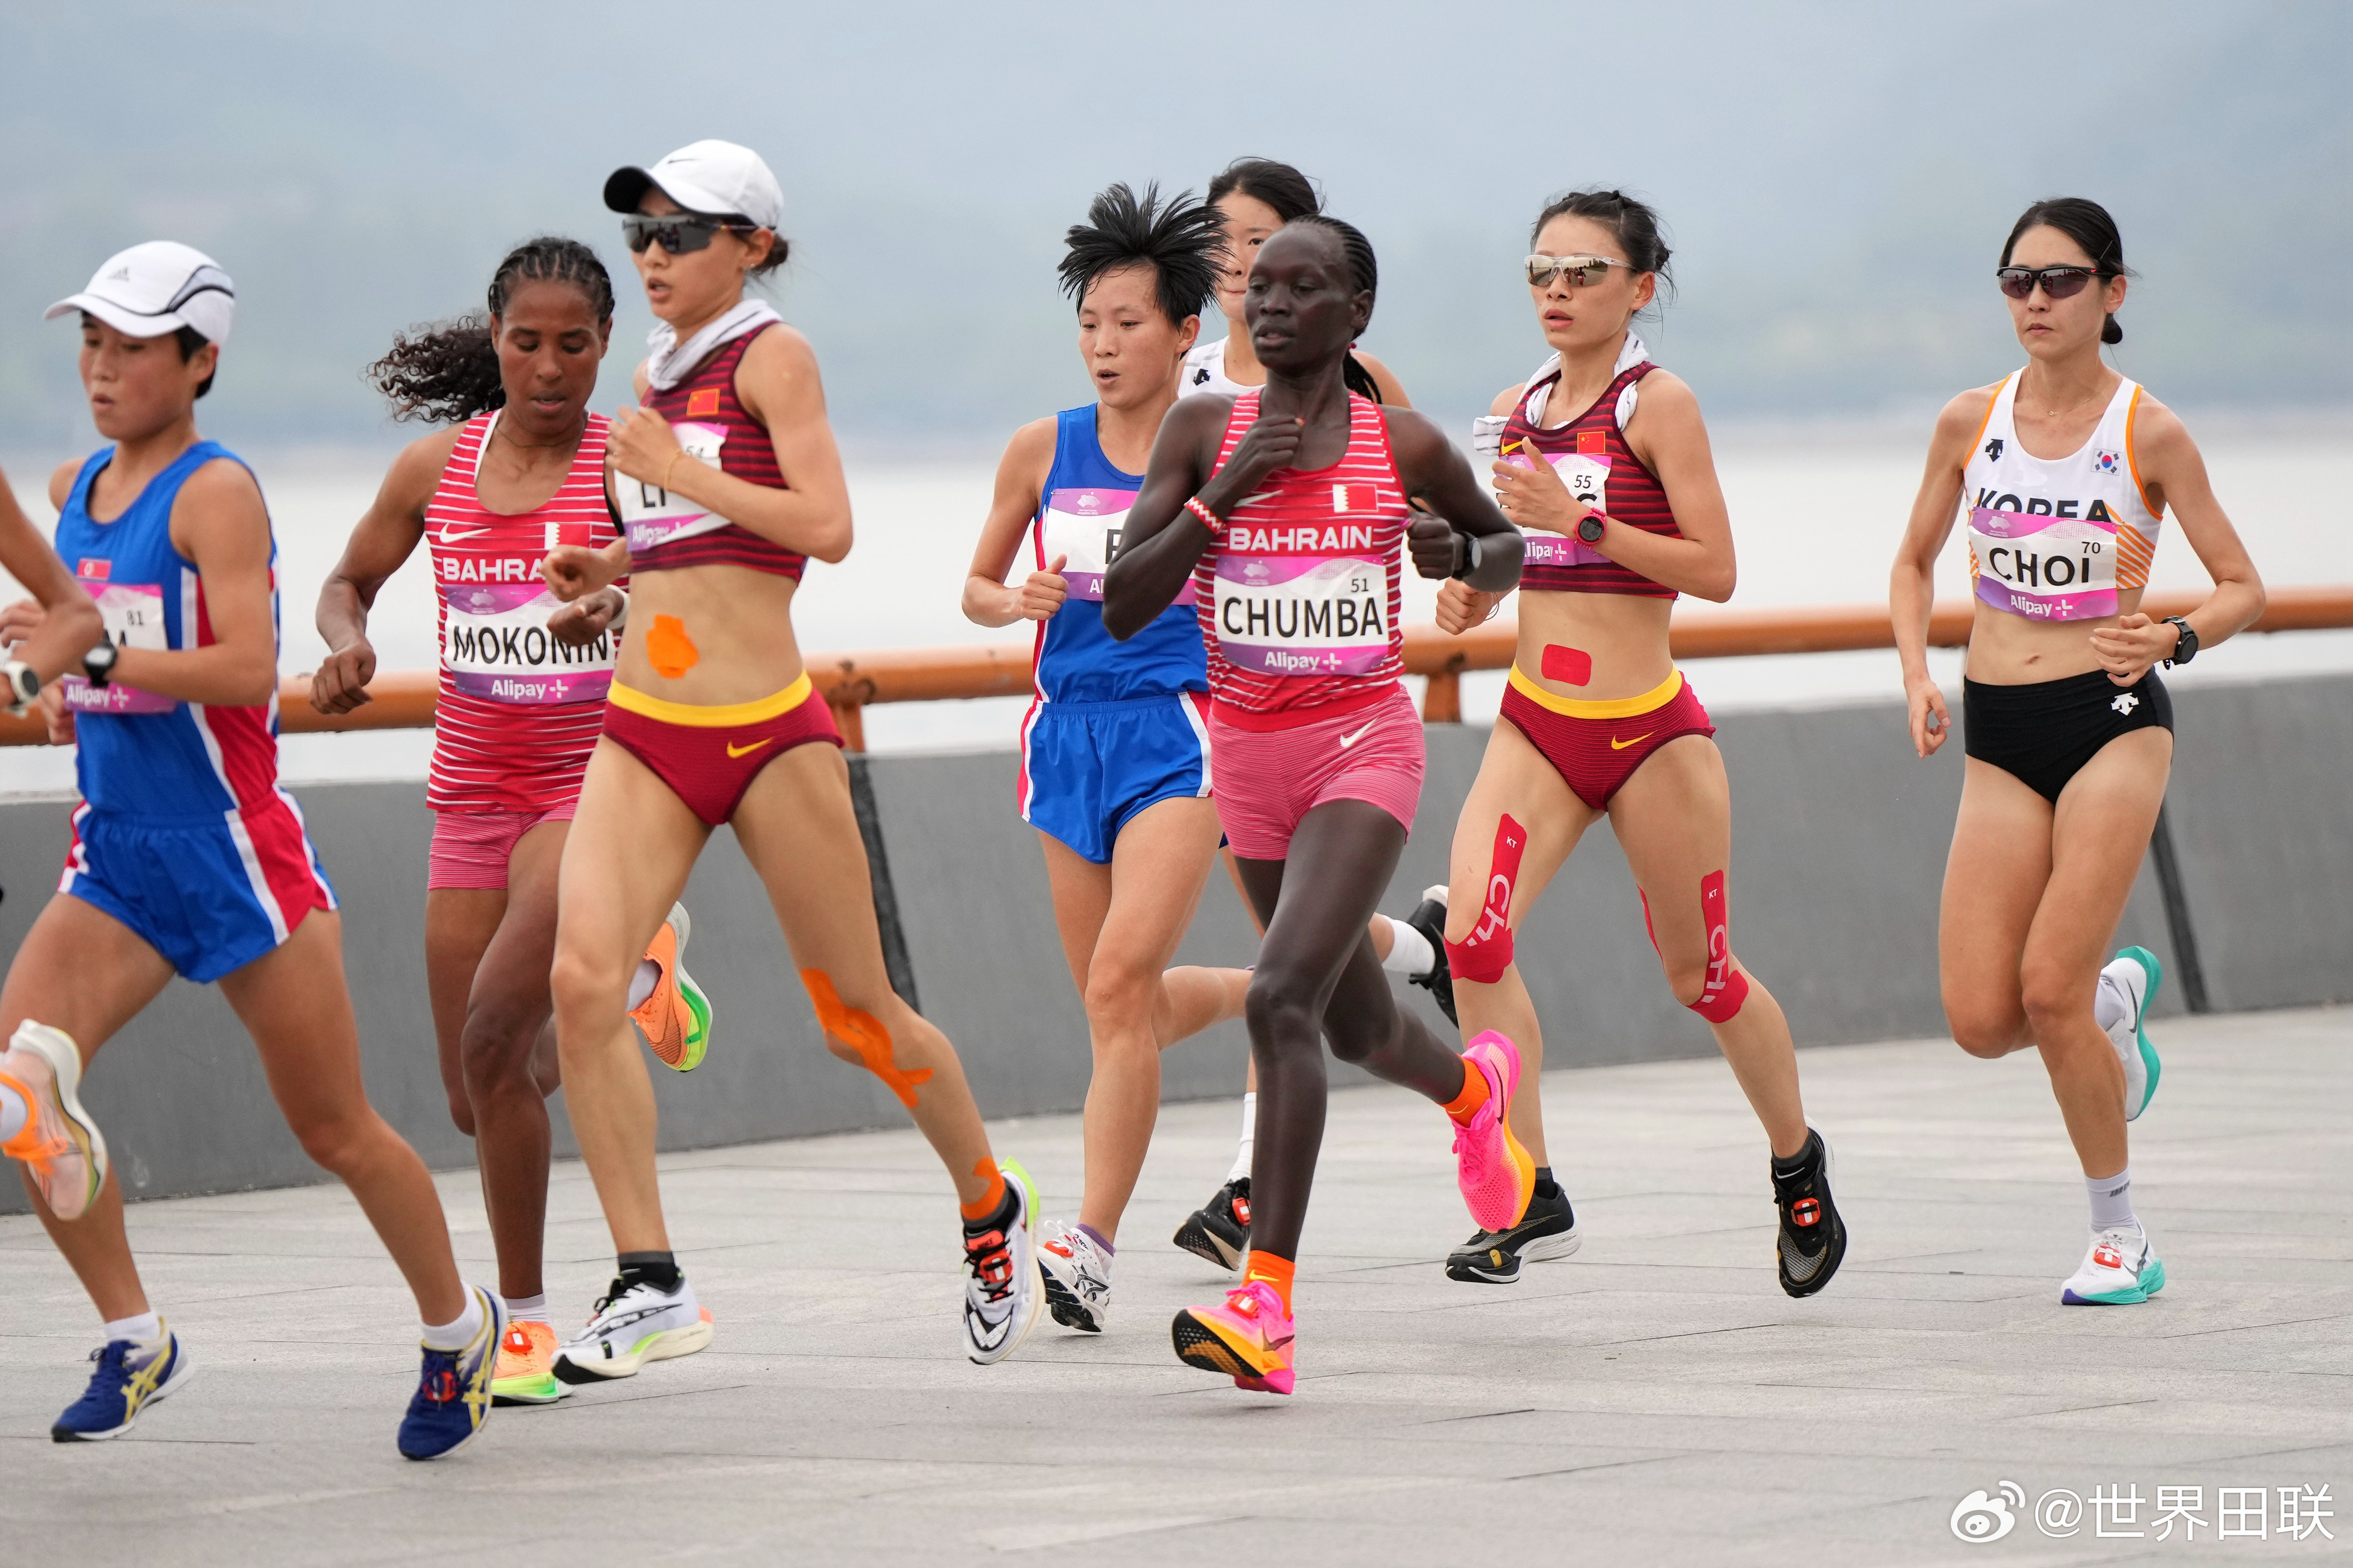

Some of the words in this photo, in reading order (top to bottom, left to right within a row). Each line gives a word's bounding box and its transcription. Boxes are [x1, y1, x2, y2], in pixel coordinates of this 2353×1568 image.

[1574, 475, 1592, 489] 55
[1229, 526, 1372, 551] BAHRAIN
[1524, 541, 1554, 560] lipay
[2081, 542, 2101, 554] 70
[442, 558, 545, 582] BAHRA
[1989, 547, 2090, 587] CHOI
[1350, 578, 1369, 593] 51
[1223, 596, 1383, 638] CHUMBA
[1507, 836, 1517, 848] KT
[1709, 888, 1718, 899] KT
